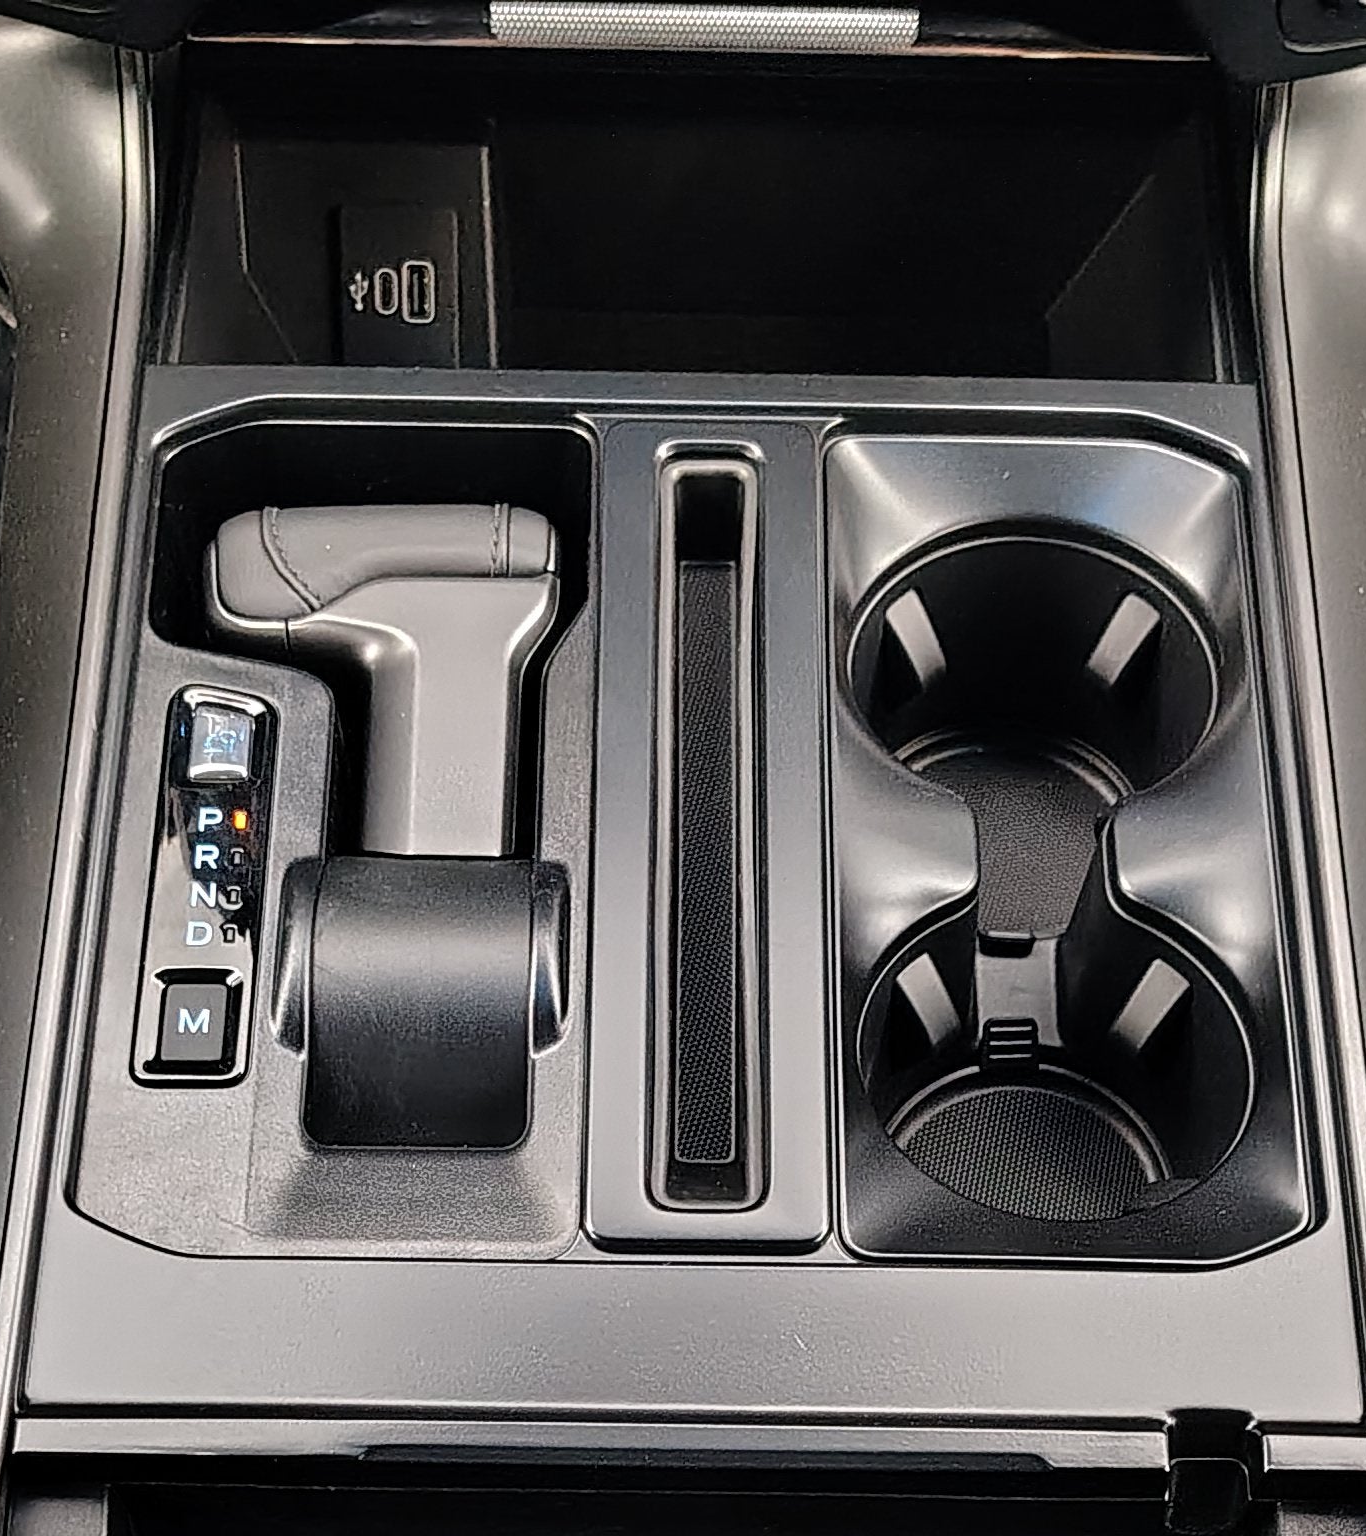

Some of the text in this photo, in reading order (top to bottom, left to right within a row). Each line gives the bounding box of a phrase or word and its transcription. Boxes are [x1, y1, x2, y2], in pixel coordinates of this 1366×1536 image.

[197, 806, 224, 833] P
[194, 844, 220, 871] R
[190, 882, 217, 909] N
[186, 920, 213, 947] D
[177, 1008, 210, 1034] M
